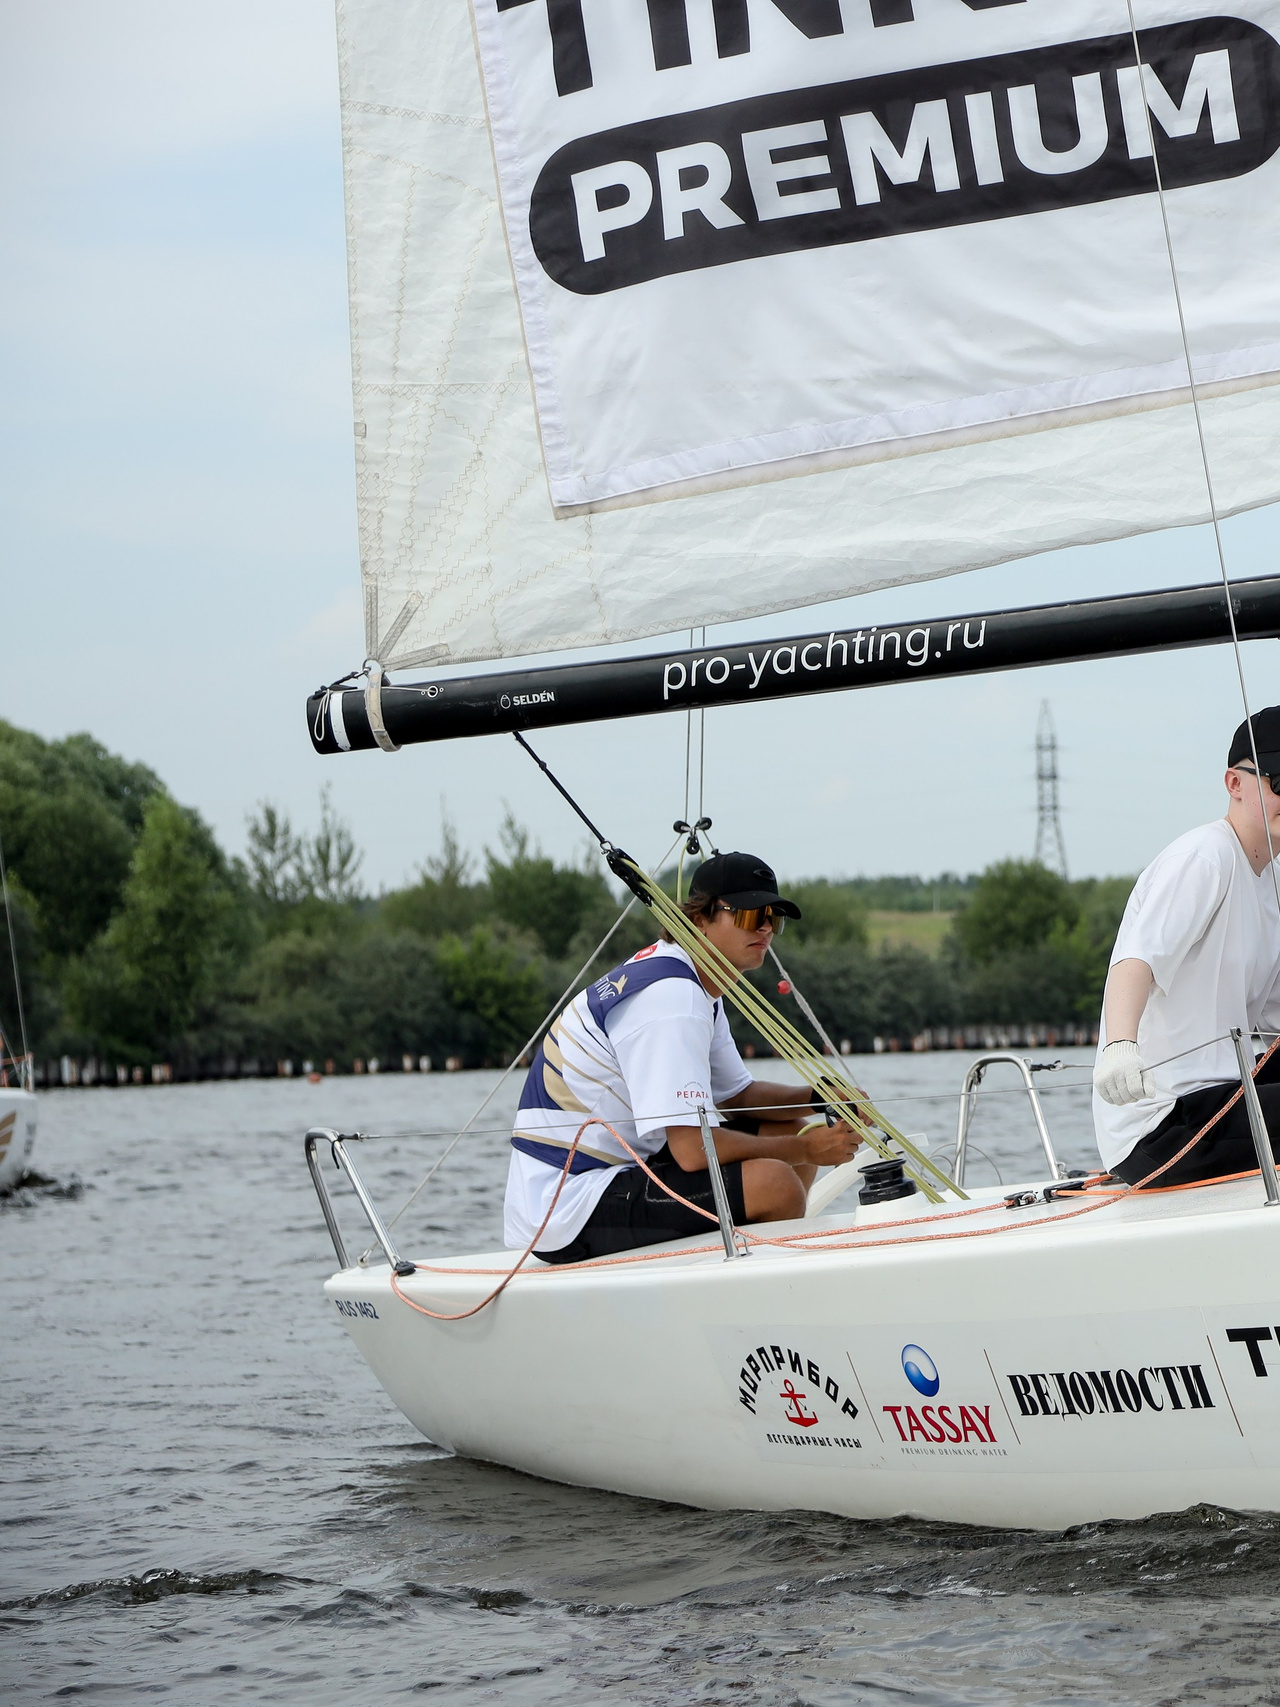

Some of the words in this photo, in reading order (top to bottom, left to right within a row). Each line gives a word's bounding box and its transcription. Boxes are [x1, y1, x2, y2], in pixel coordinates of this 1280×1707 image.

[570, 48, 1242, 263] PREMIUM
[662, 619, 987, 700] pro-yachting.ru
[512, 690, 555, 706] SELDÉN
[676, 1091, 709, 1099] РЕГАТА
[335, 1300, 357, 1317] RUS
[738, 1345, 859, 1420] МОРПРИБОР
[1006, 1365, 1216, 1421] ВЕДОМОСТИ
[882, 1405, 998, 1443] TASSAY
[766, 1433, 833, 1447] ЛЕГЕНДАРНЫЕ
[835, 1437, 862, 1448] ЧАСЫ
[901, 1447, 936, 1456] PREMIUM
[938, 1448, 978, 1456] DRINKING
[981, 1448, 1008, 1456] WATER
